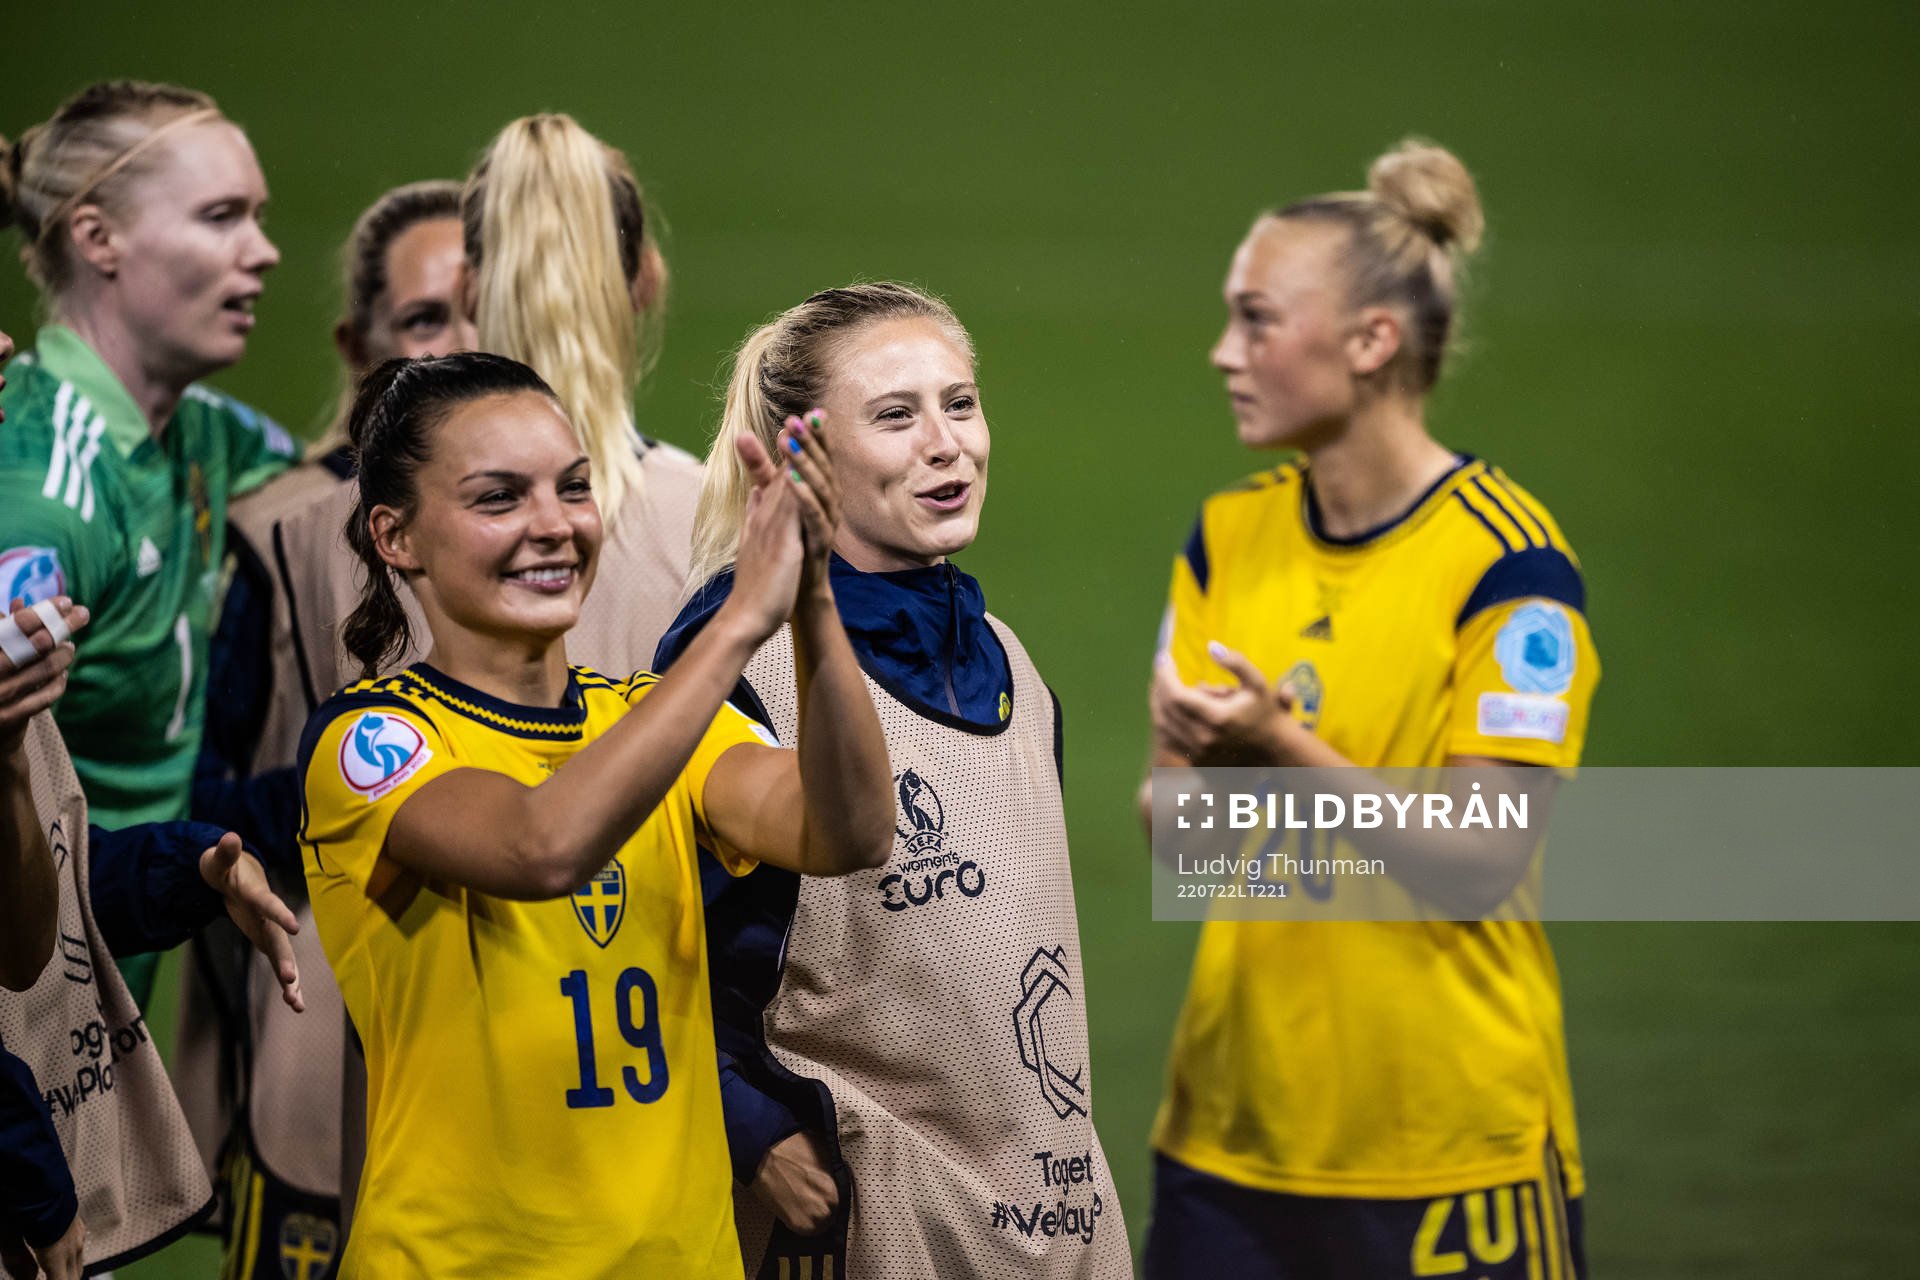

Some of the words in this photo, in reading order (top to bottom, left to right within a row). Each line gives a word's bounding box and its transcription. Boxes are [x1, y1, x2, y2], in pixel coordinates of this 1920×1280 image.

[897, 851, 960, 874] women's
[907, 835, 942, 854] UEFA
[559, 966, 669, 1109] 19
[1410, 1185, 1519, 1277] 20
